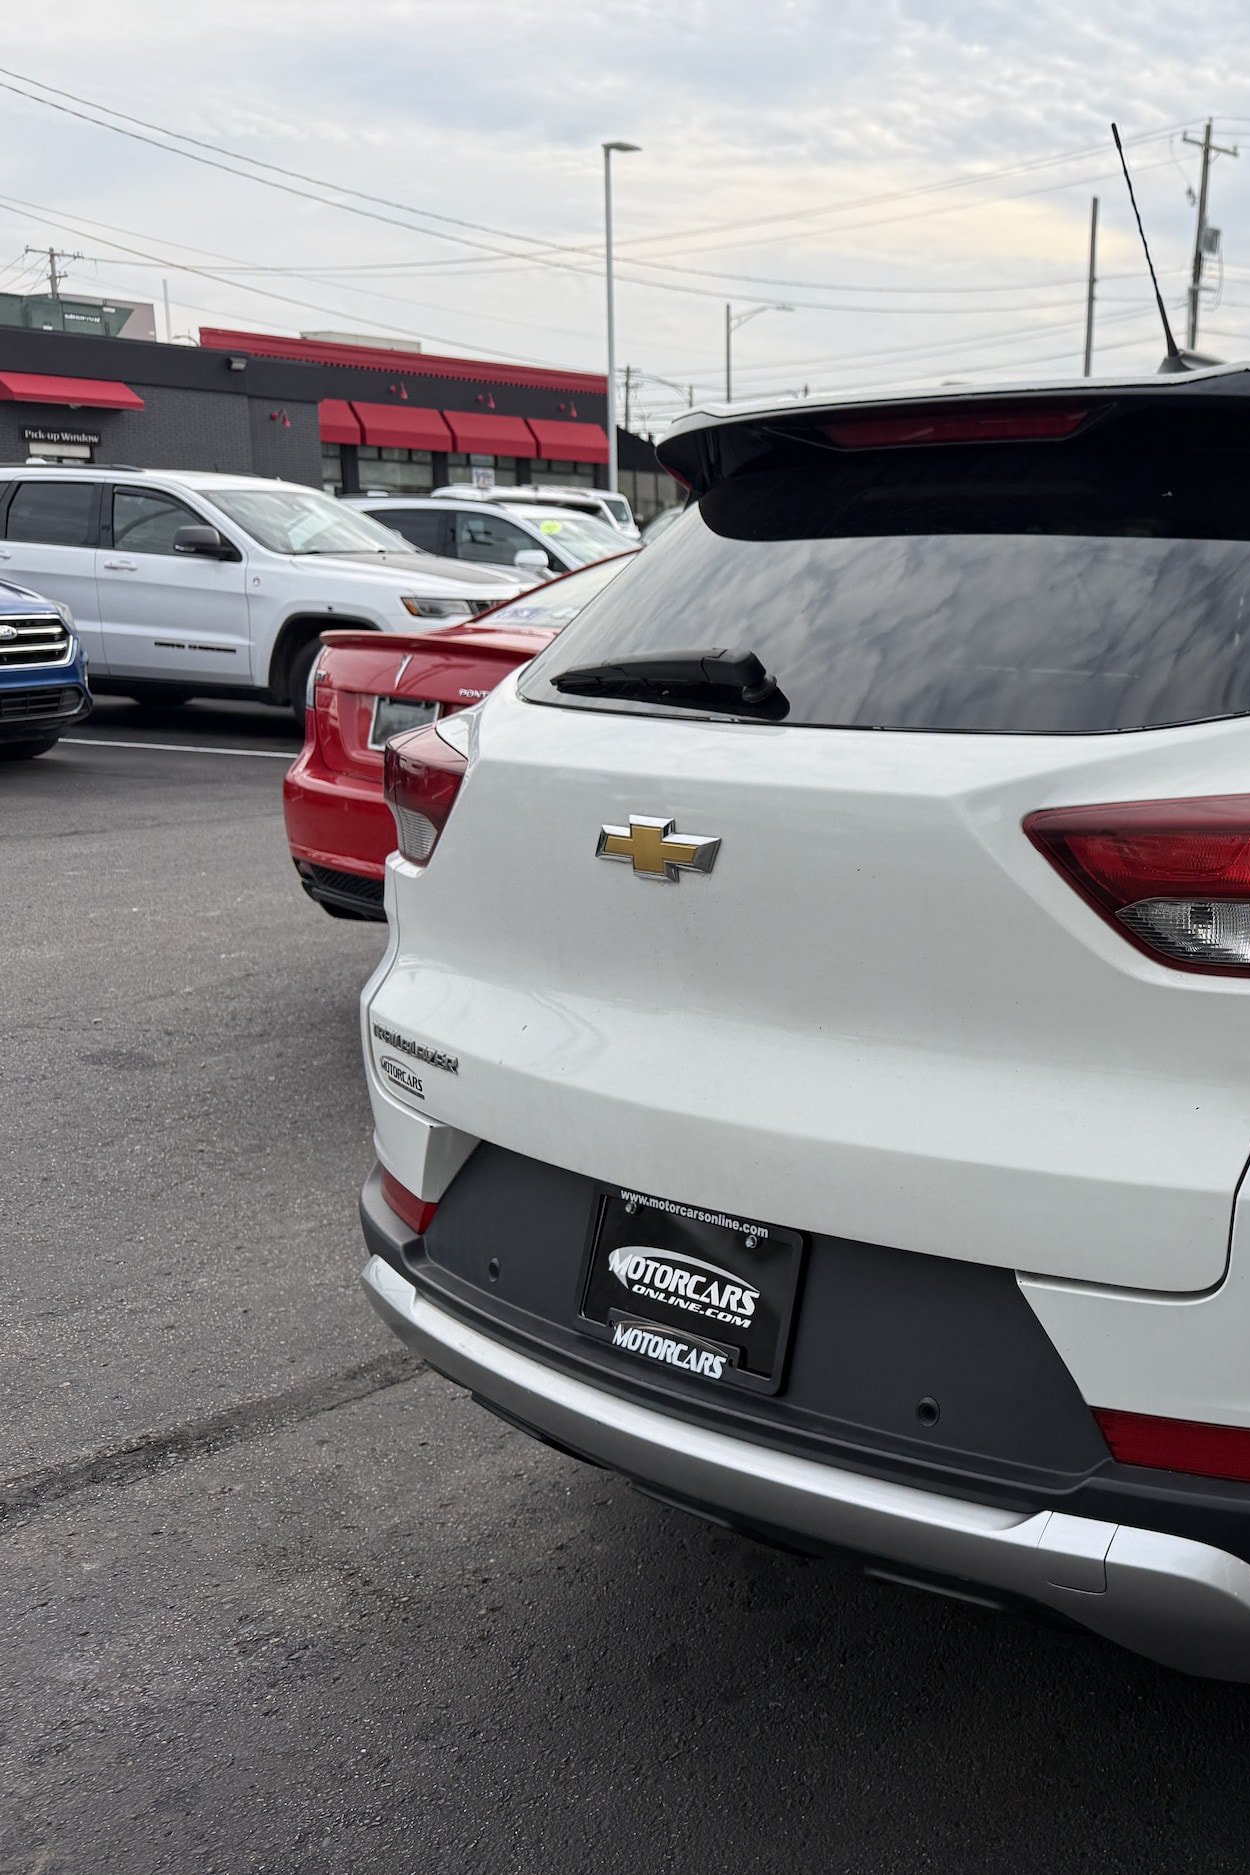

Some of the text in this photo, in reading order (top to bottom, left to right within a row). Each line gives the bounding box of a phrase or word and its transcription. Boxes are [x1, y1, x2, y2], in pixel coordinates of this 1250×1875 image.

[25, 429, 100, 443] Pick-up Window
[620, 1190, 769, 1239] www.motorcarsonline.com
[609, 1248, 760, 1316] MOTORCARS
[631, 1284, 753, 1329] ONLINE.COM
[612, 1323, 728, 1380] MOTORCARS
